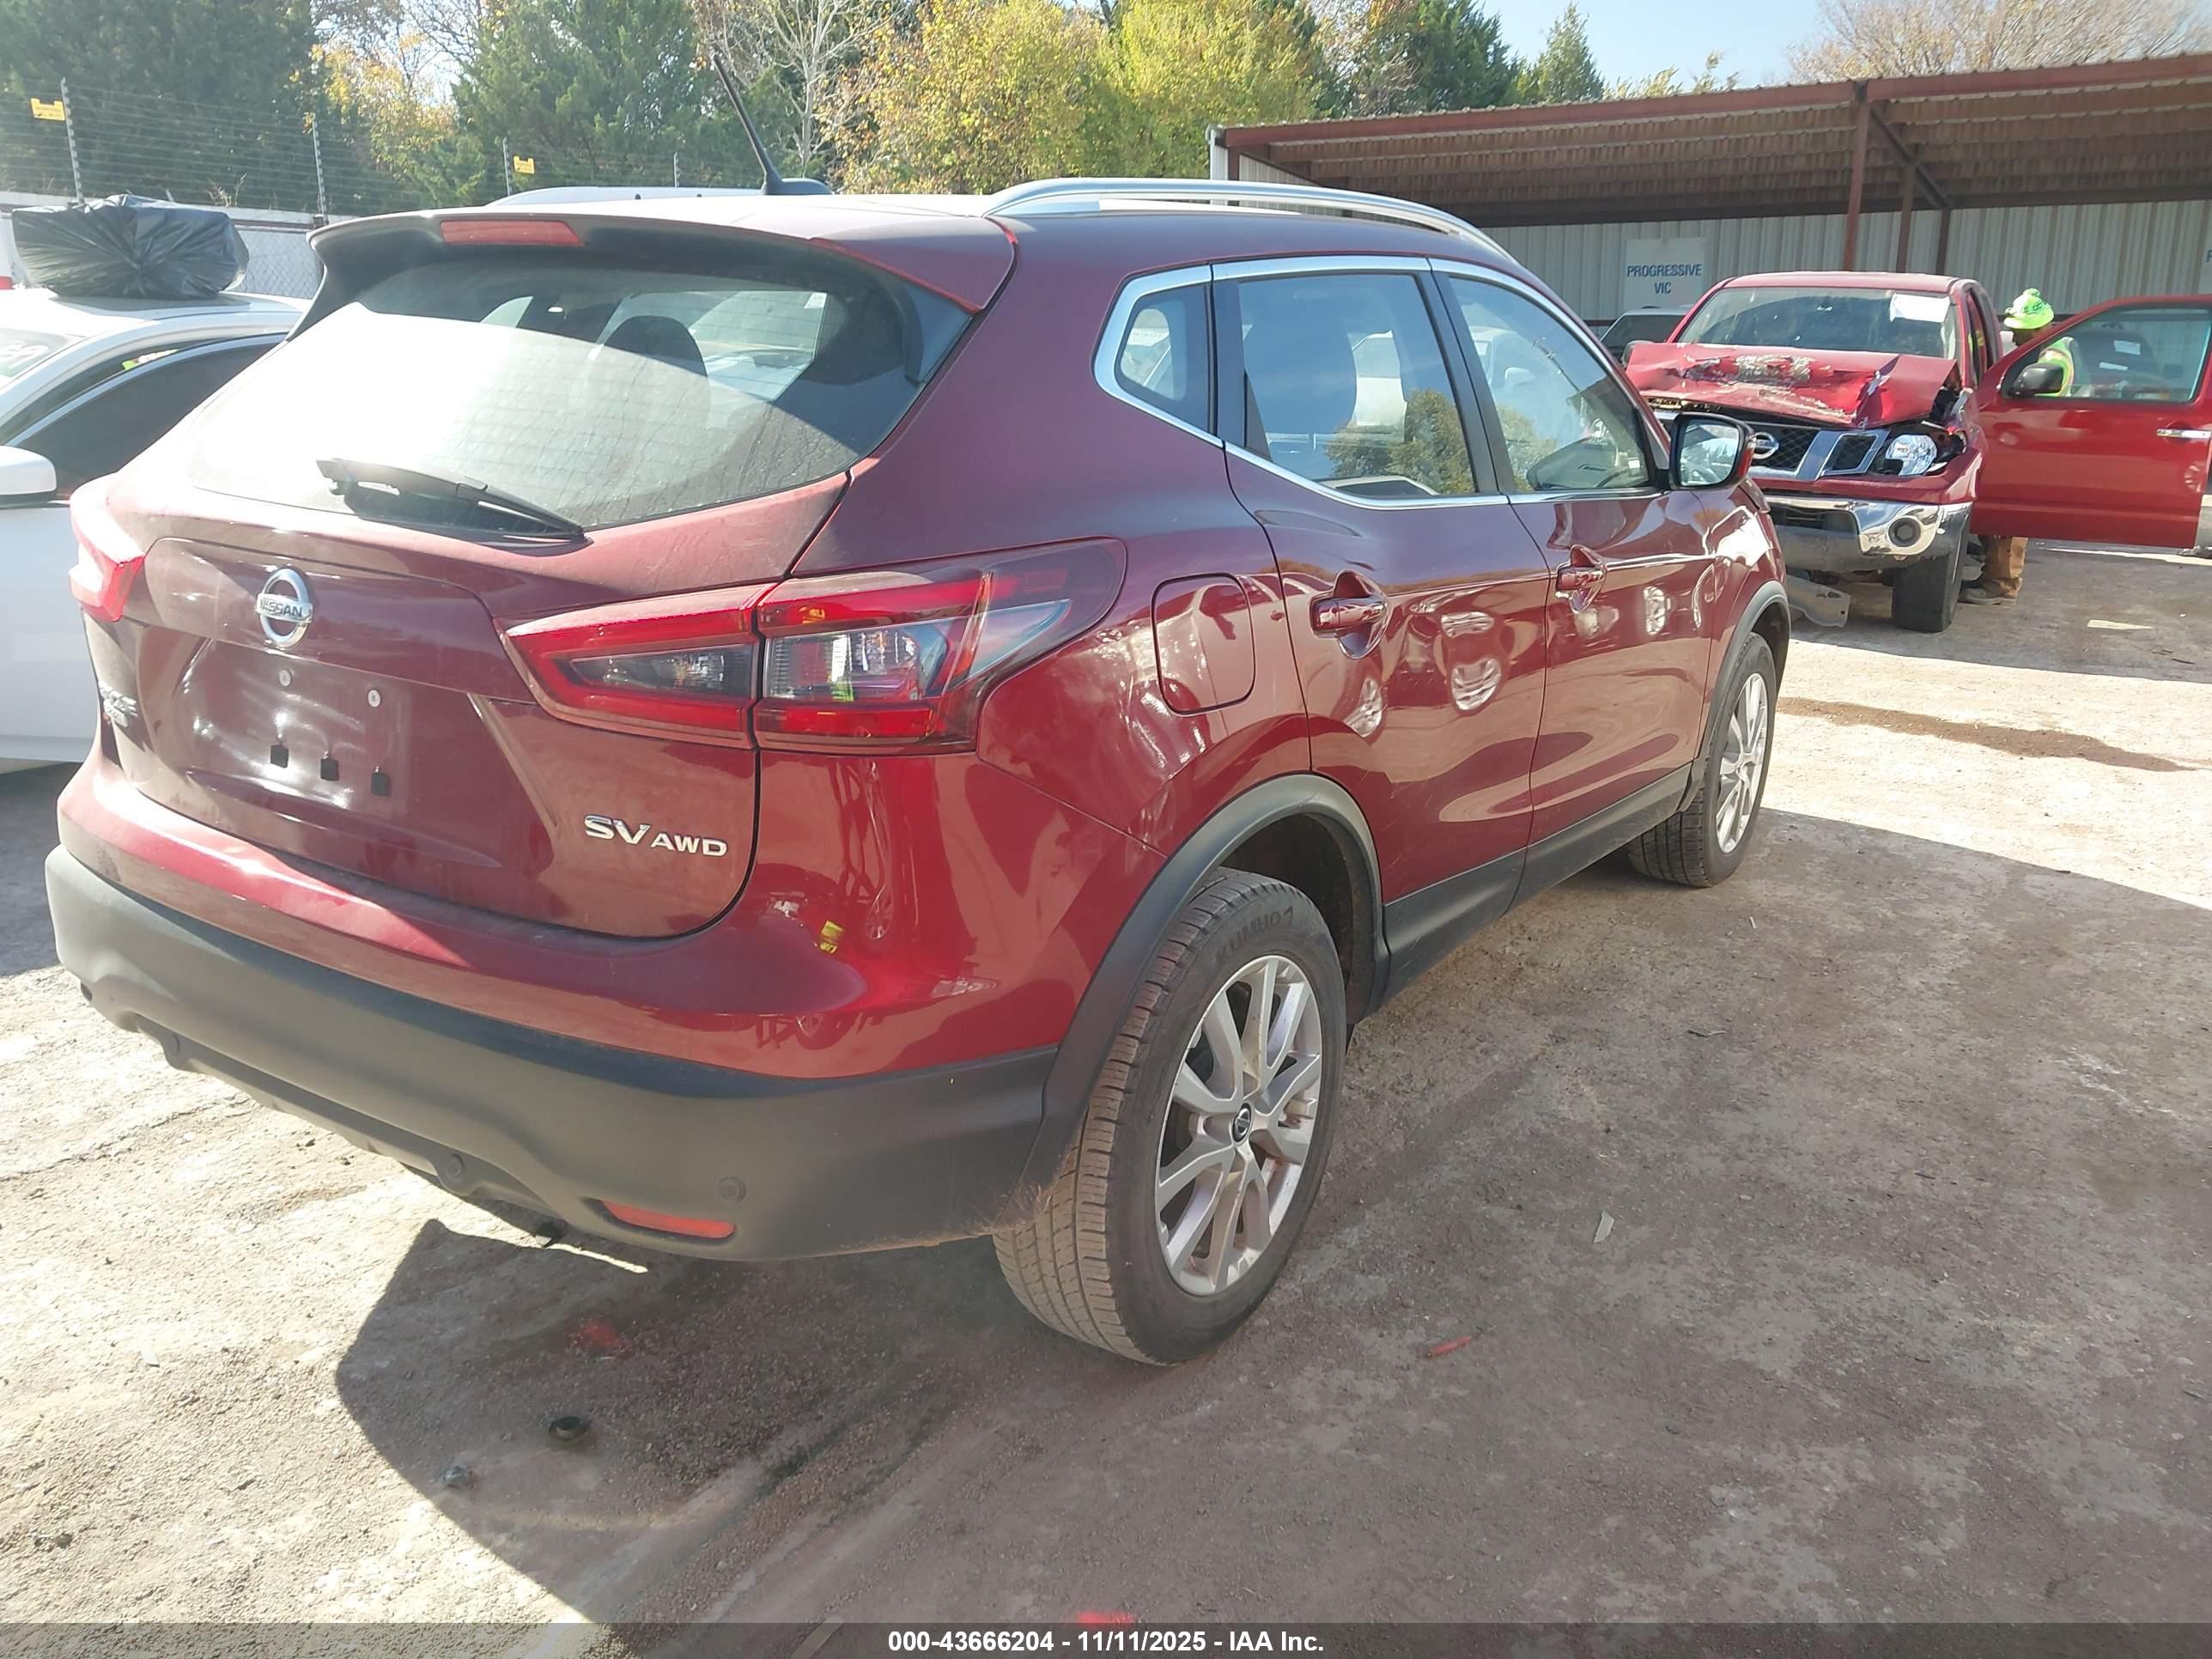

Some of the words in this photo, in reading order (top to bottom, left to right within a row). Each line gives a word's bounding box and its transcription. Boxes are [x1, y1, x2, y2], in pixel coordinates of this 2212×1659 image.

[1626, 264, 1702, 276] PROGRESSIVE
[1654, 282, 1672, 295] VIC
[584, 815, 651, 845] SV
[650, 832, 728, 857] AWD
